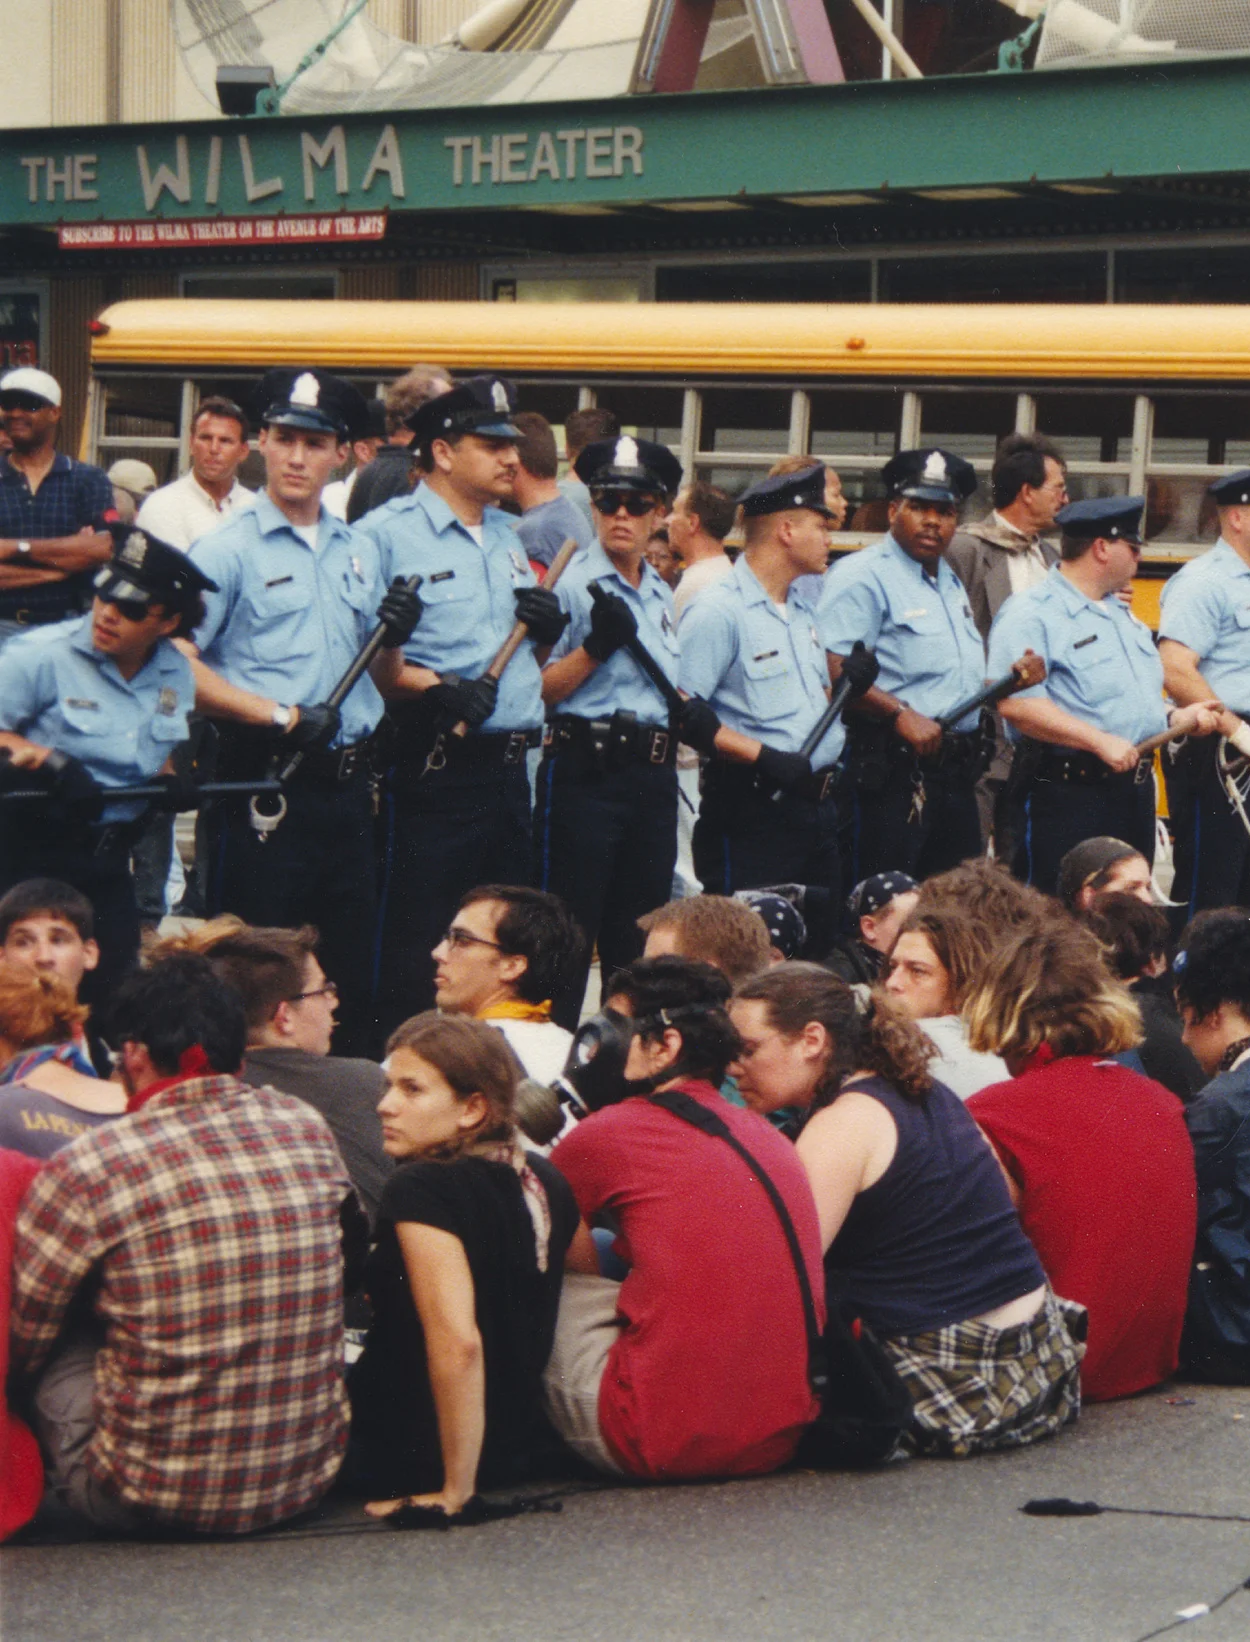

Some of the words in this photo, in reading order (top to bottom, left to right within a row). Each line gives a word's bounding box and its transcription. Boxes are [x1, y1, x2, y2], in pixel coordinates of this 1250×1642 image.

[20, 155, 99, 203] THE
[136, 124, 406, 212] WILMA
[444, 125, 645, 187] THEATER
[62, 224, 116, 244] SUBSCRIBE
[118, 223, 133, 242] TO
[135, 223, 155, 242] THE
[156, 222, 191, 241] WILMA
[191, 220, 237, 240] THEATER
[238, 220, 253, 239] ON
[255, 219, 275, 239] THE
[277, 218, 318, 237] AVENUE
[318, 217, 333, 236] OF
[334, 216, 357, 235] THE
[357, 215, 385, 235] ARTS
